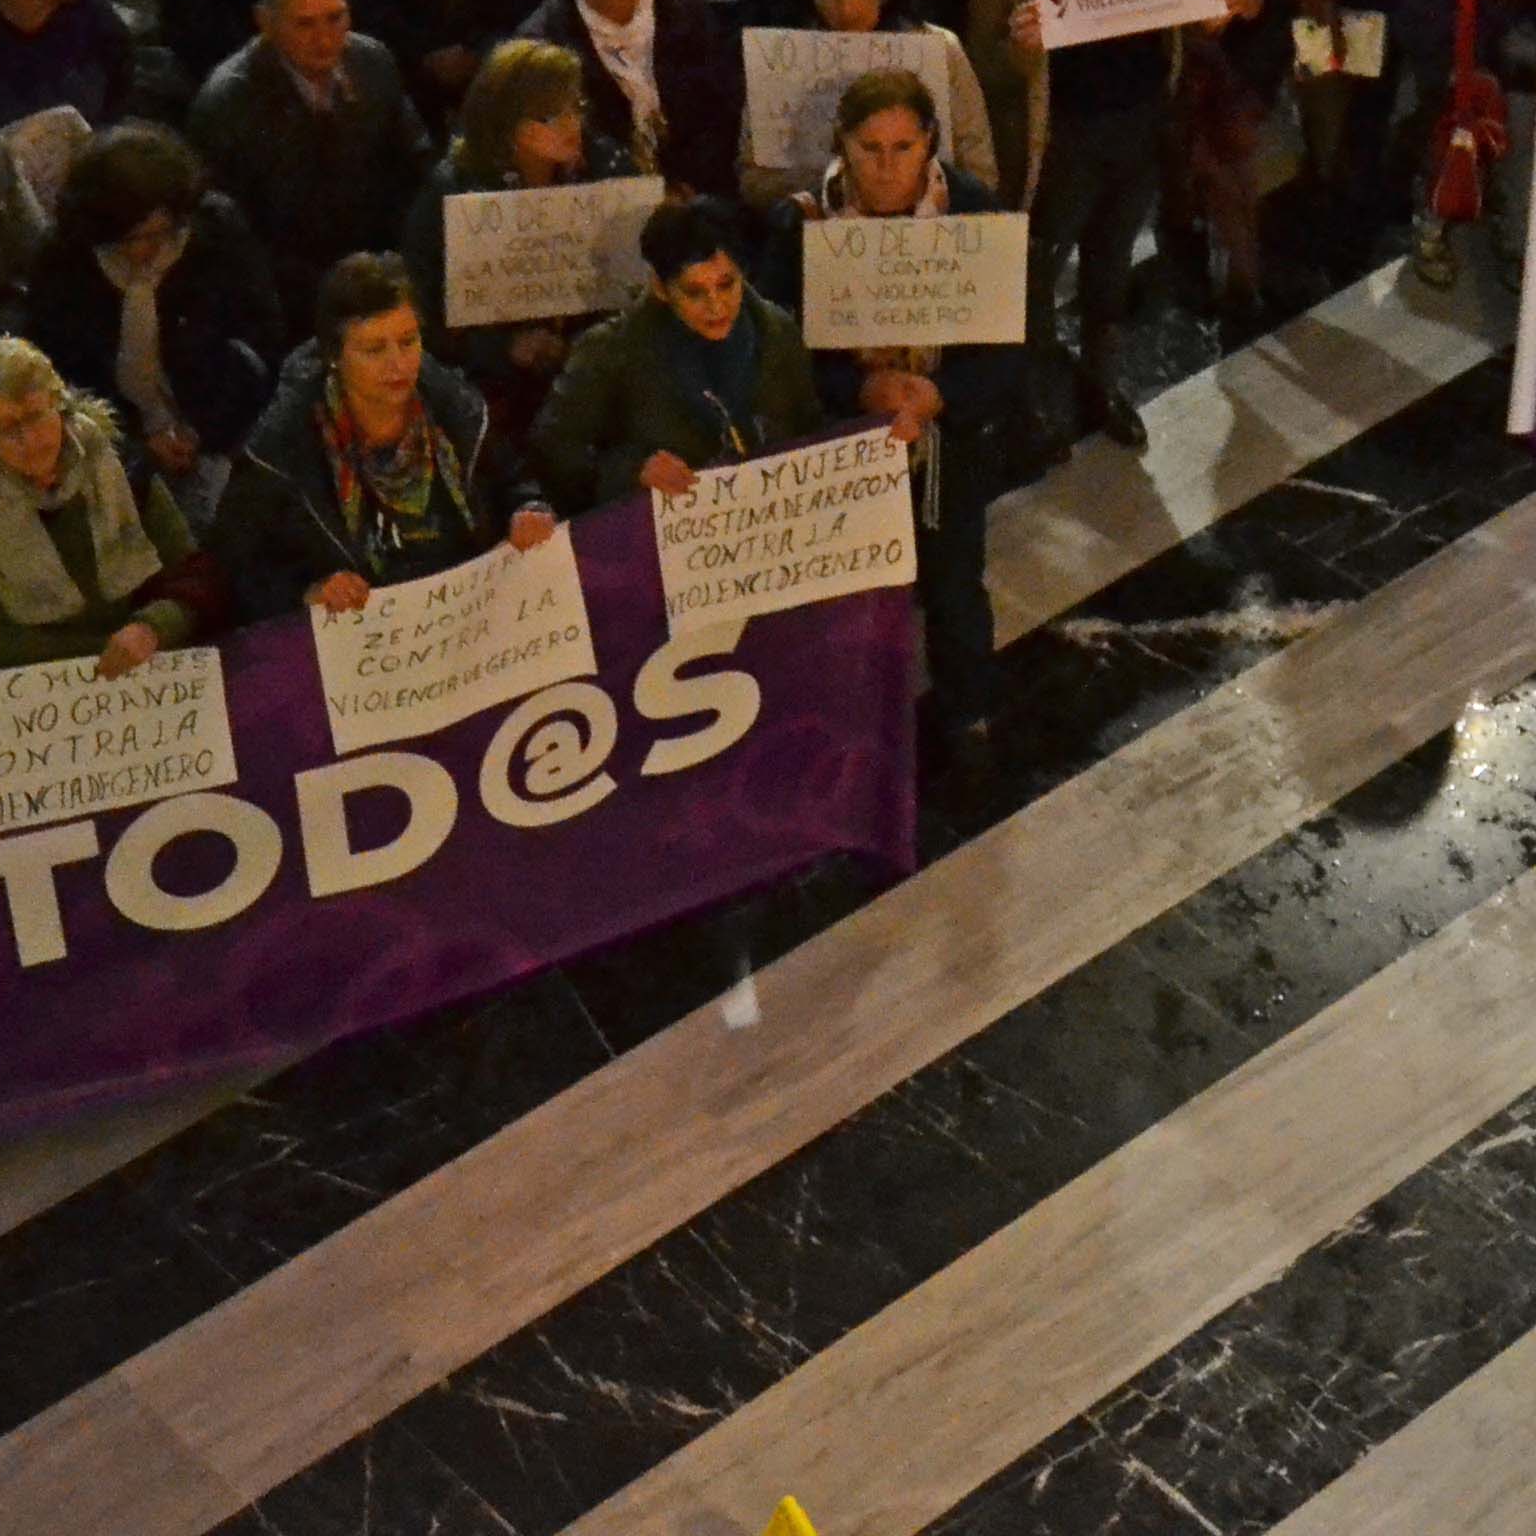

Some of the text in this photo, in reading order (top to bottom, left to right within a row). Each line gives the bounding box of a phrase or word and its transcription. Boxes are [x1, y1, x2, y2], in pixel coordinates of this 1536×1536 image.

[821, 220, 983, 260] VO DE MU
[878, 260, 962, 277] CONTRA
[829, 278, 978, 304] LA VIOLENCIA
[828, 304, 974, 327] DE GENERO
[760, 432, 897, 496] MUJERES
[662, 500, 778, 550] AGUSTINA
[807, 469, 909, 511] ARAGON
[686, 511, 847, 571] CONTRA LA
[356, 587, 558, 678] CONTRA LA
[39, 649, 211, 693] MURES
[69, 676, 207, 727] GRANDE
[151, 708, 200, 749] LA
